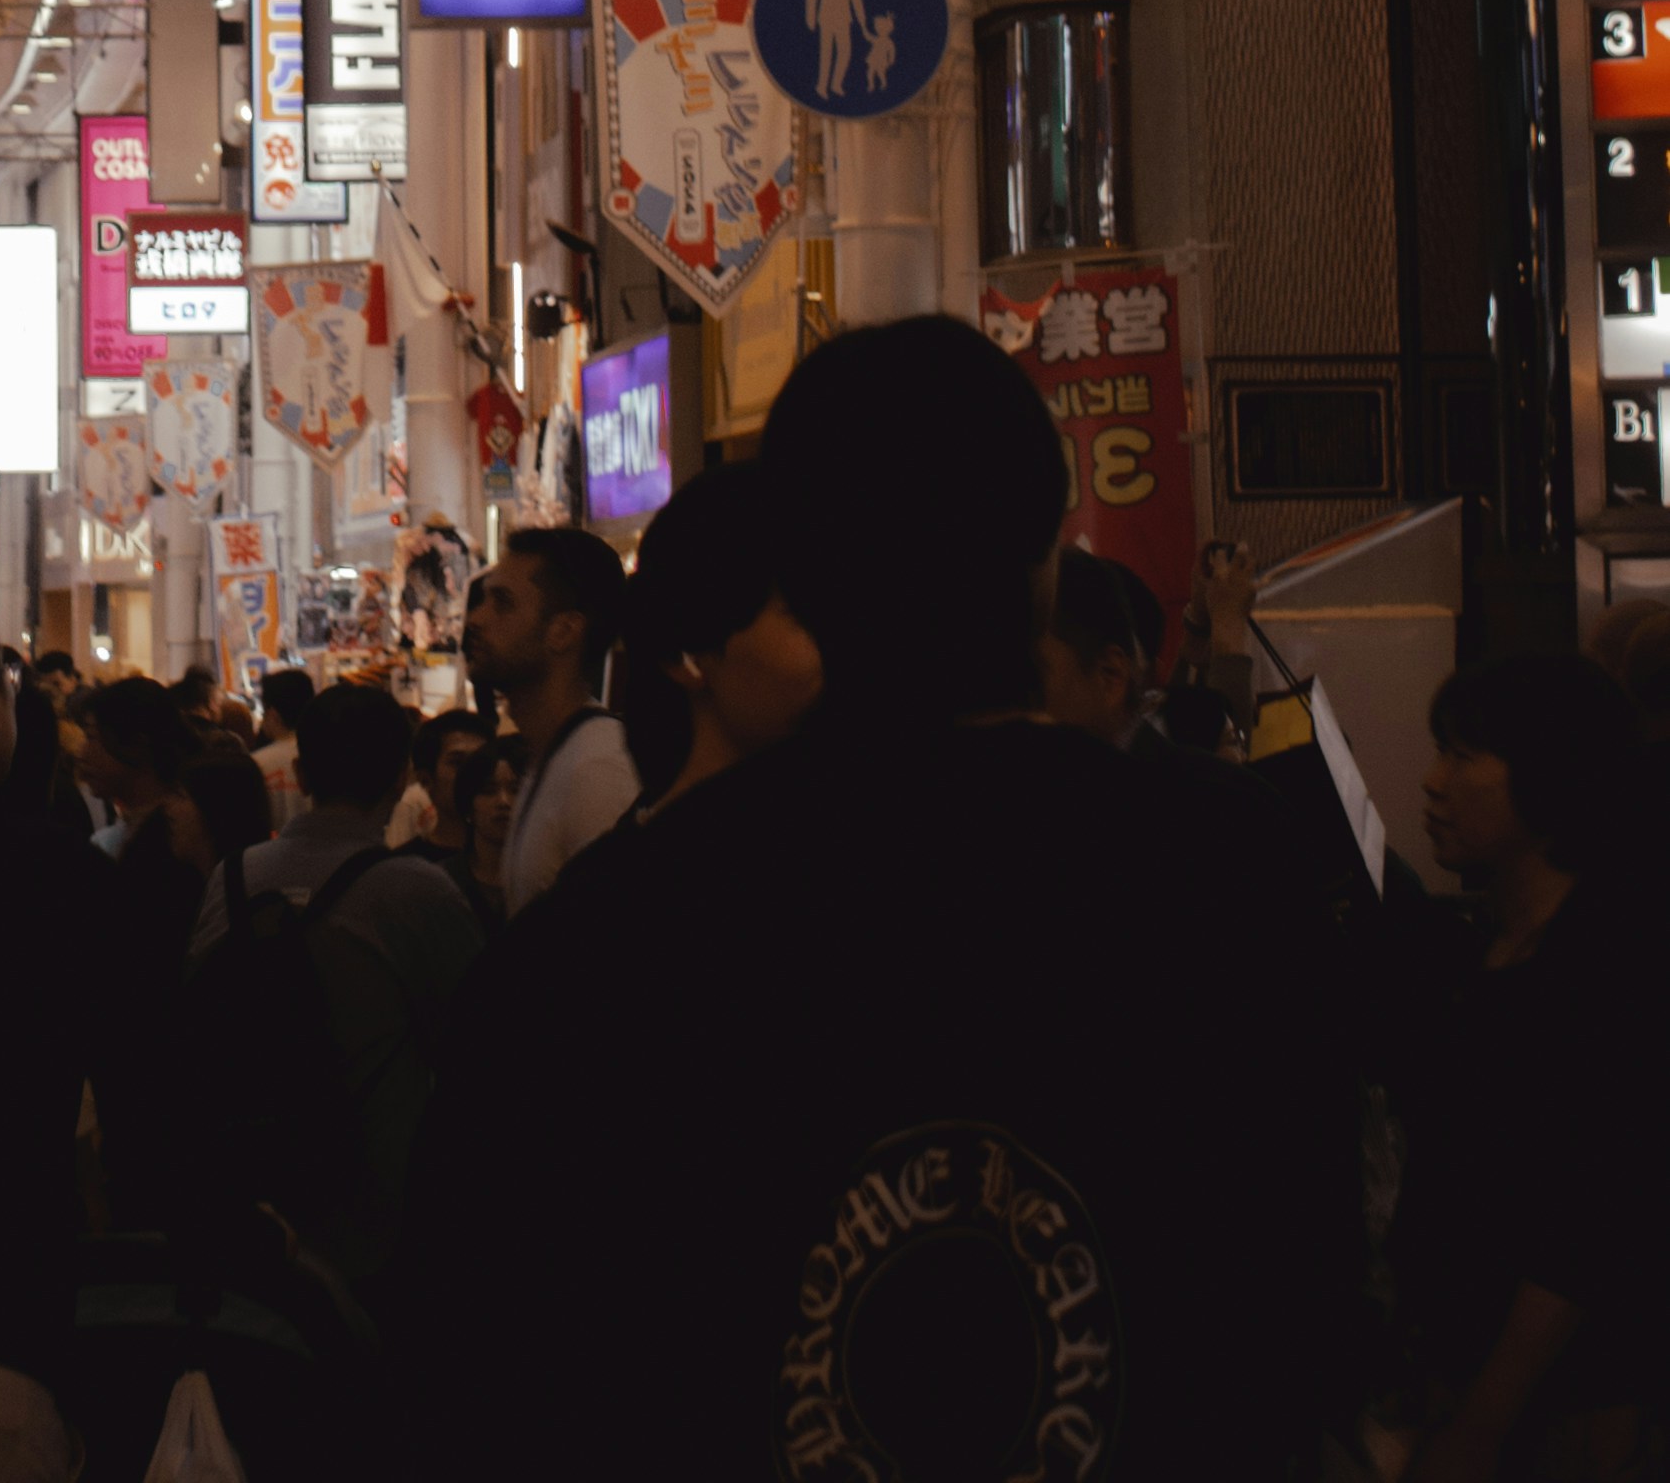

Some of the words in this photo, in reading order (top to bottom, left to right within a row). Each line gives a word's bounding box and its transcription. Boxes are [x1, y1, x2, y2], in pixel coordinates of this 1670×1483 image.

[1602, 9, 1637, 58] 3
[1607, 135, 1636, 177] 2
[1617, 267, 1642, 313] 1
